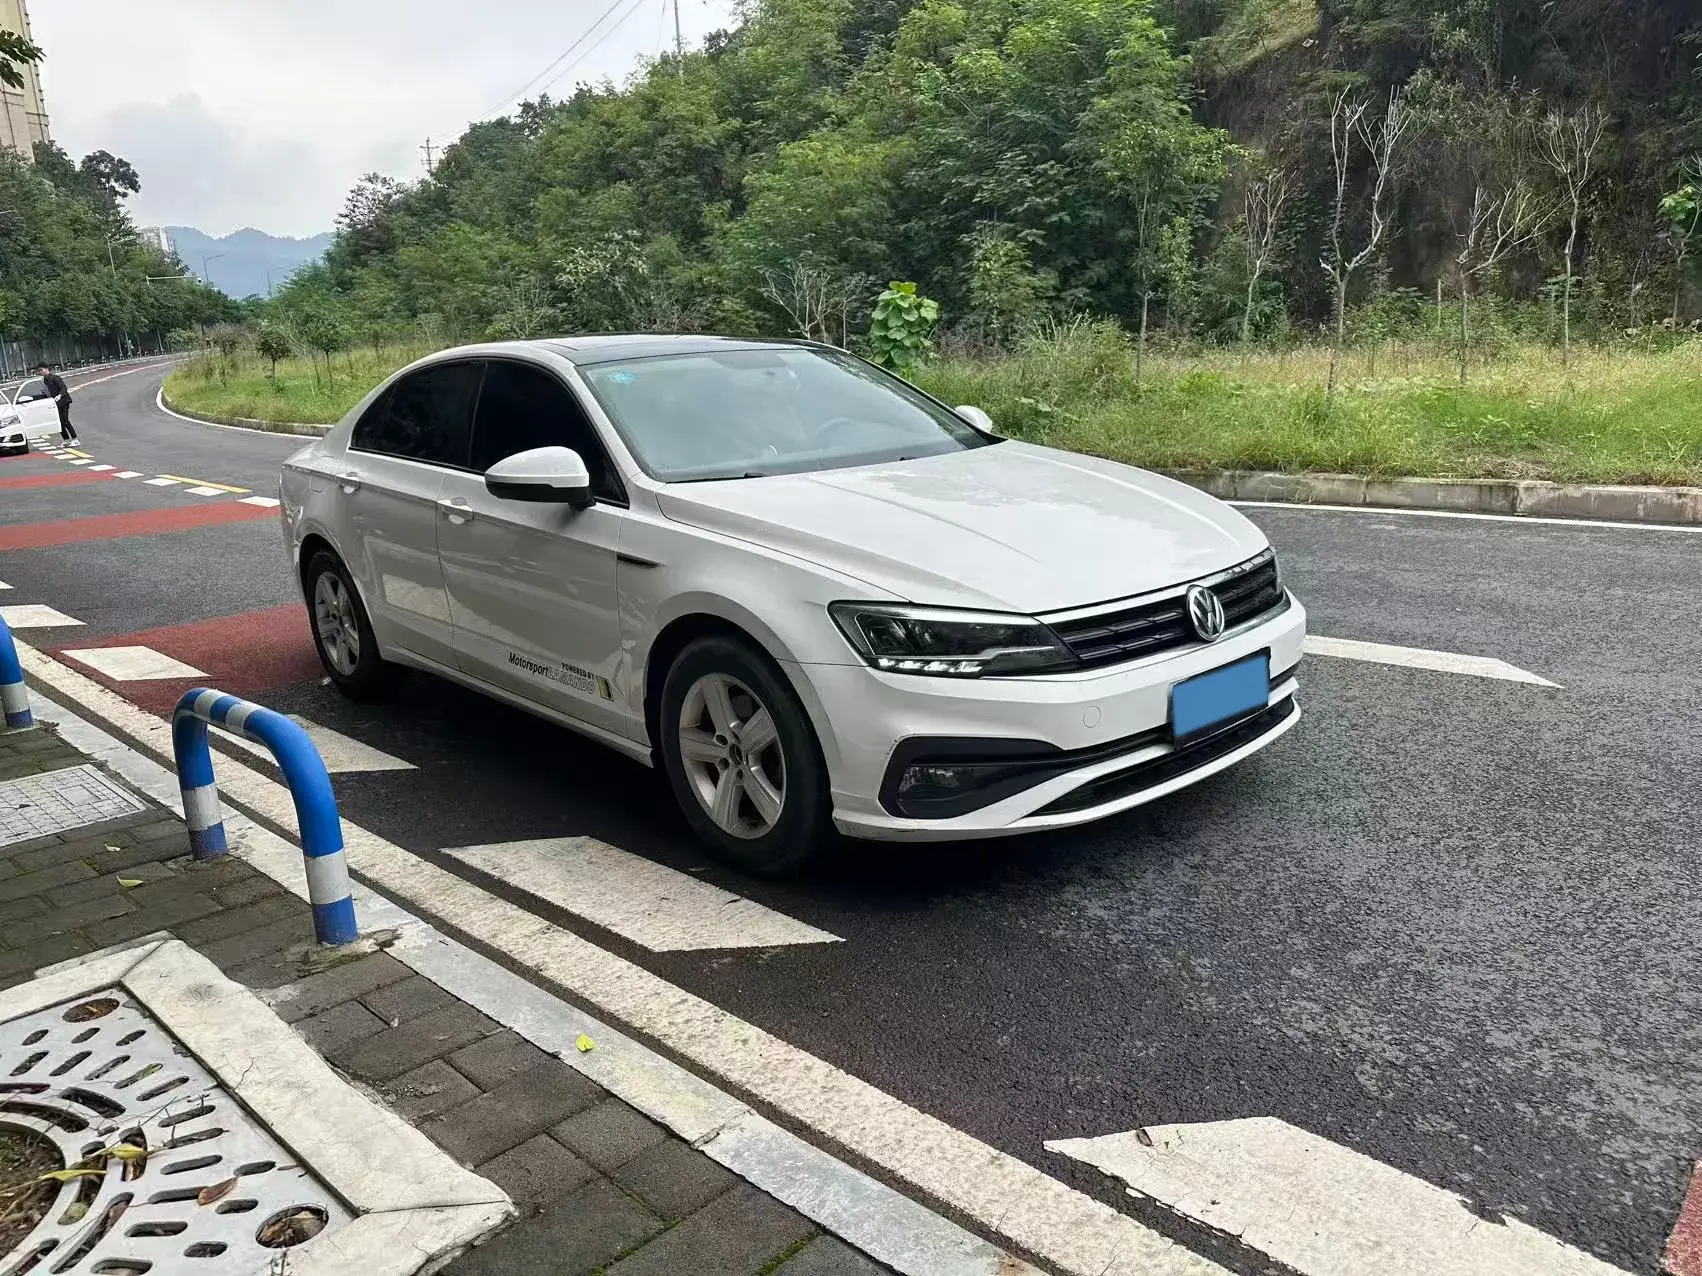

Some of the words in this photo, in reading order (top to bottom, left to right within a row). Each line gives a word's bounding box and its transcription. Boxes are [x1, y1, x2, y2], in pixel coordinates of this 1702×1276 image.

[508, 651, 549, 677] Motorsport
[561, 662, 587, 678] POWERED
[587, 671, 595, 680] BY
